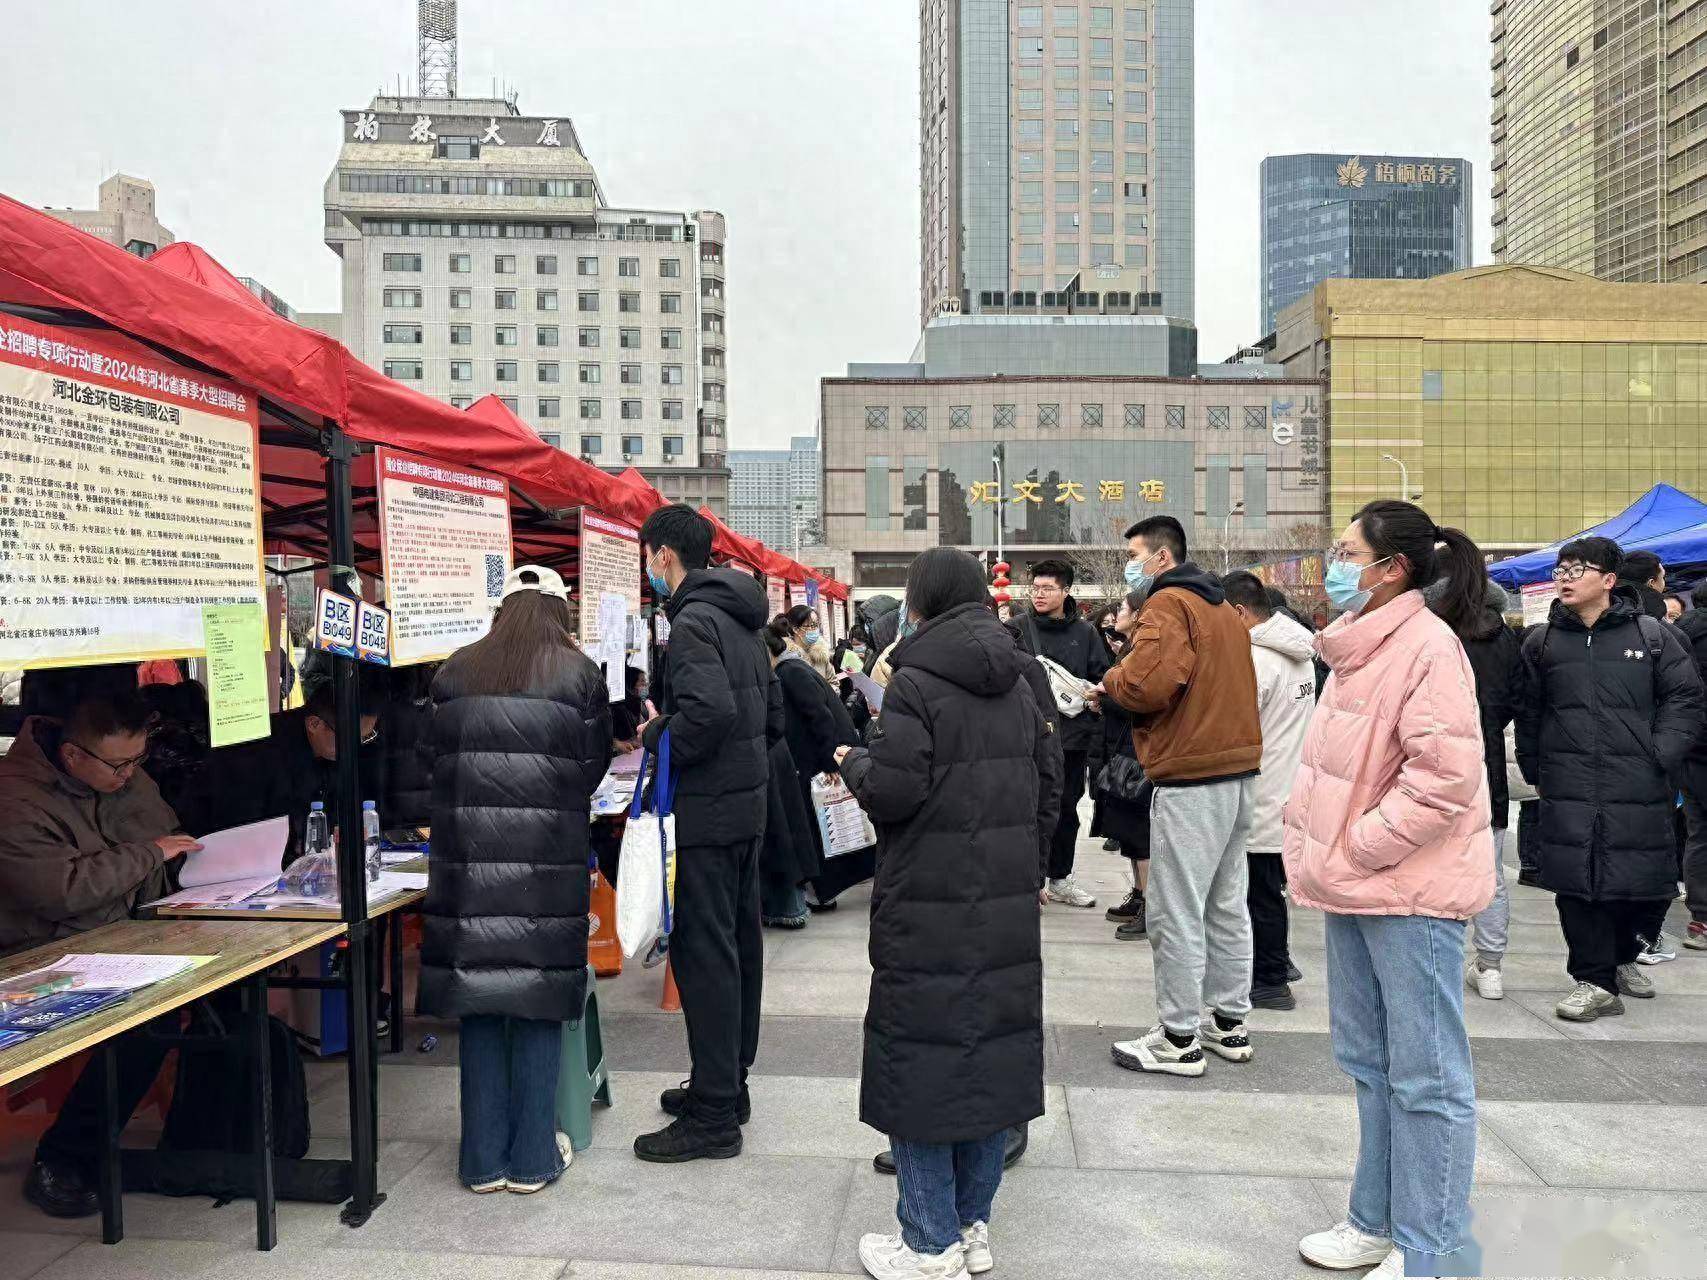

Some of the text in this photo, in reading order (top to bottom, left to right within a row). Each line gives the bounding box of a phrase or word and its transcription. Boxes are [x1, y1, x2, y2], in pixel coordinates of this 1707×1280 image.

[1374, 161, 1457, 185] 梧桐商务
[52, 378, 180, 425] 河北金环包装有限公司
[970, 479, 1167, 505] 汇文大酒店
[325, 598, 351, 624] B区
[362, 610, 385, 634] B区
[323, 620, 352, 641] B049
[361, 631, 386, 650] B048
